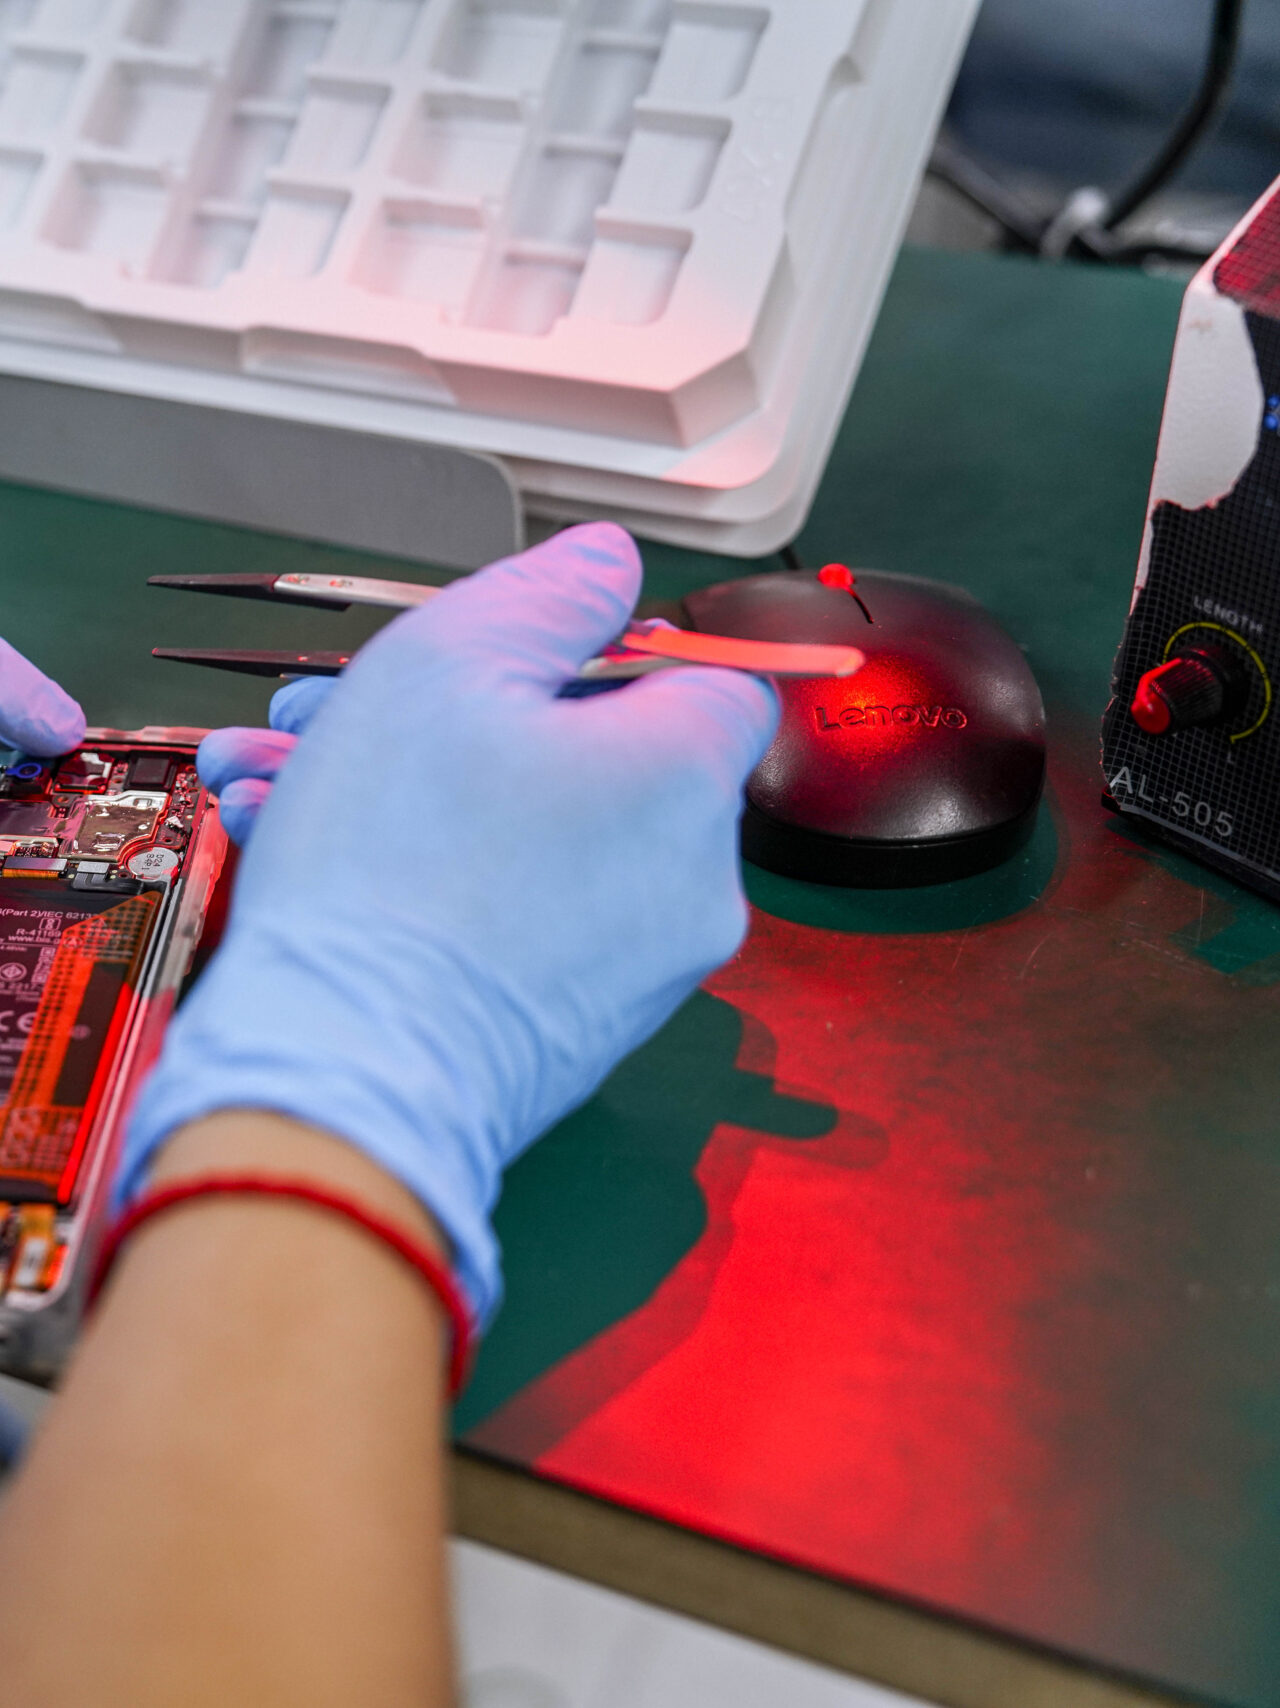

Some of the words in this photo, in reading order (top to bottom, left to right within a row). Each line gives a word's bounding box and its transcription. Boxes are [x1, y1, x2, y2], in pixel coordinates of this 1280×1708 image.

[1193, 595, 1264, 635] LENGTH
[813, 704, 968, 735] Lenovo
[1109, 766, 1234, 837] AL-505
